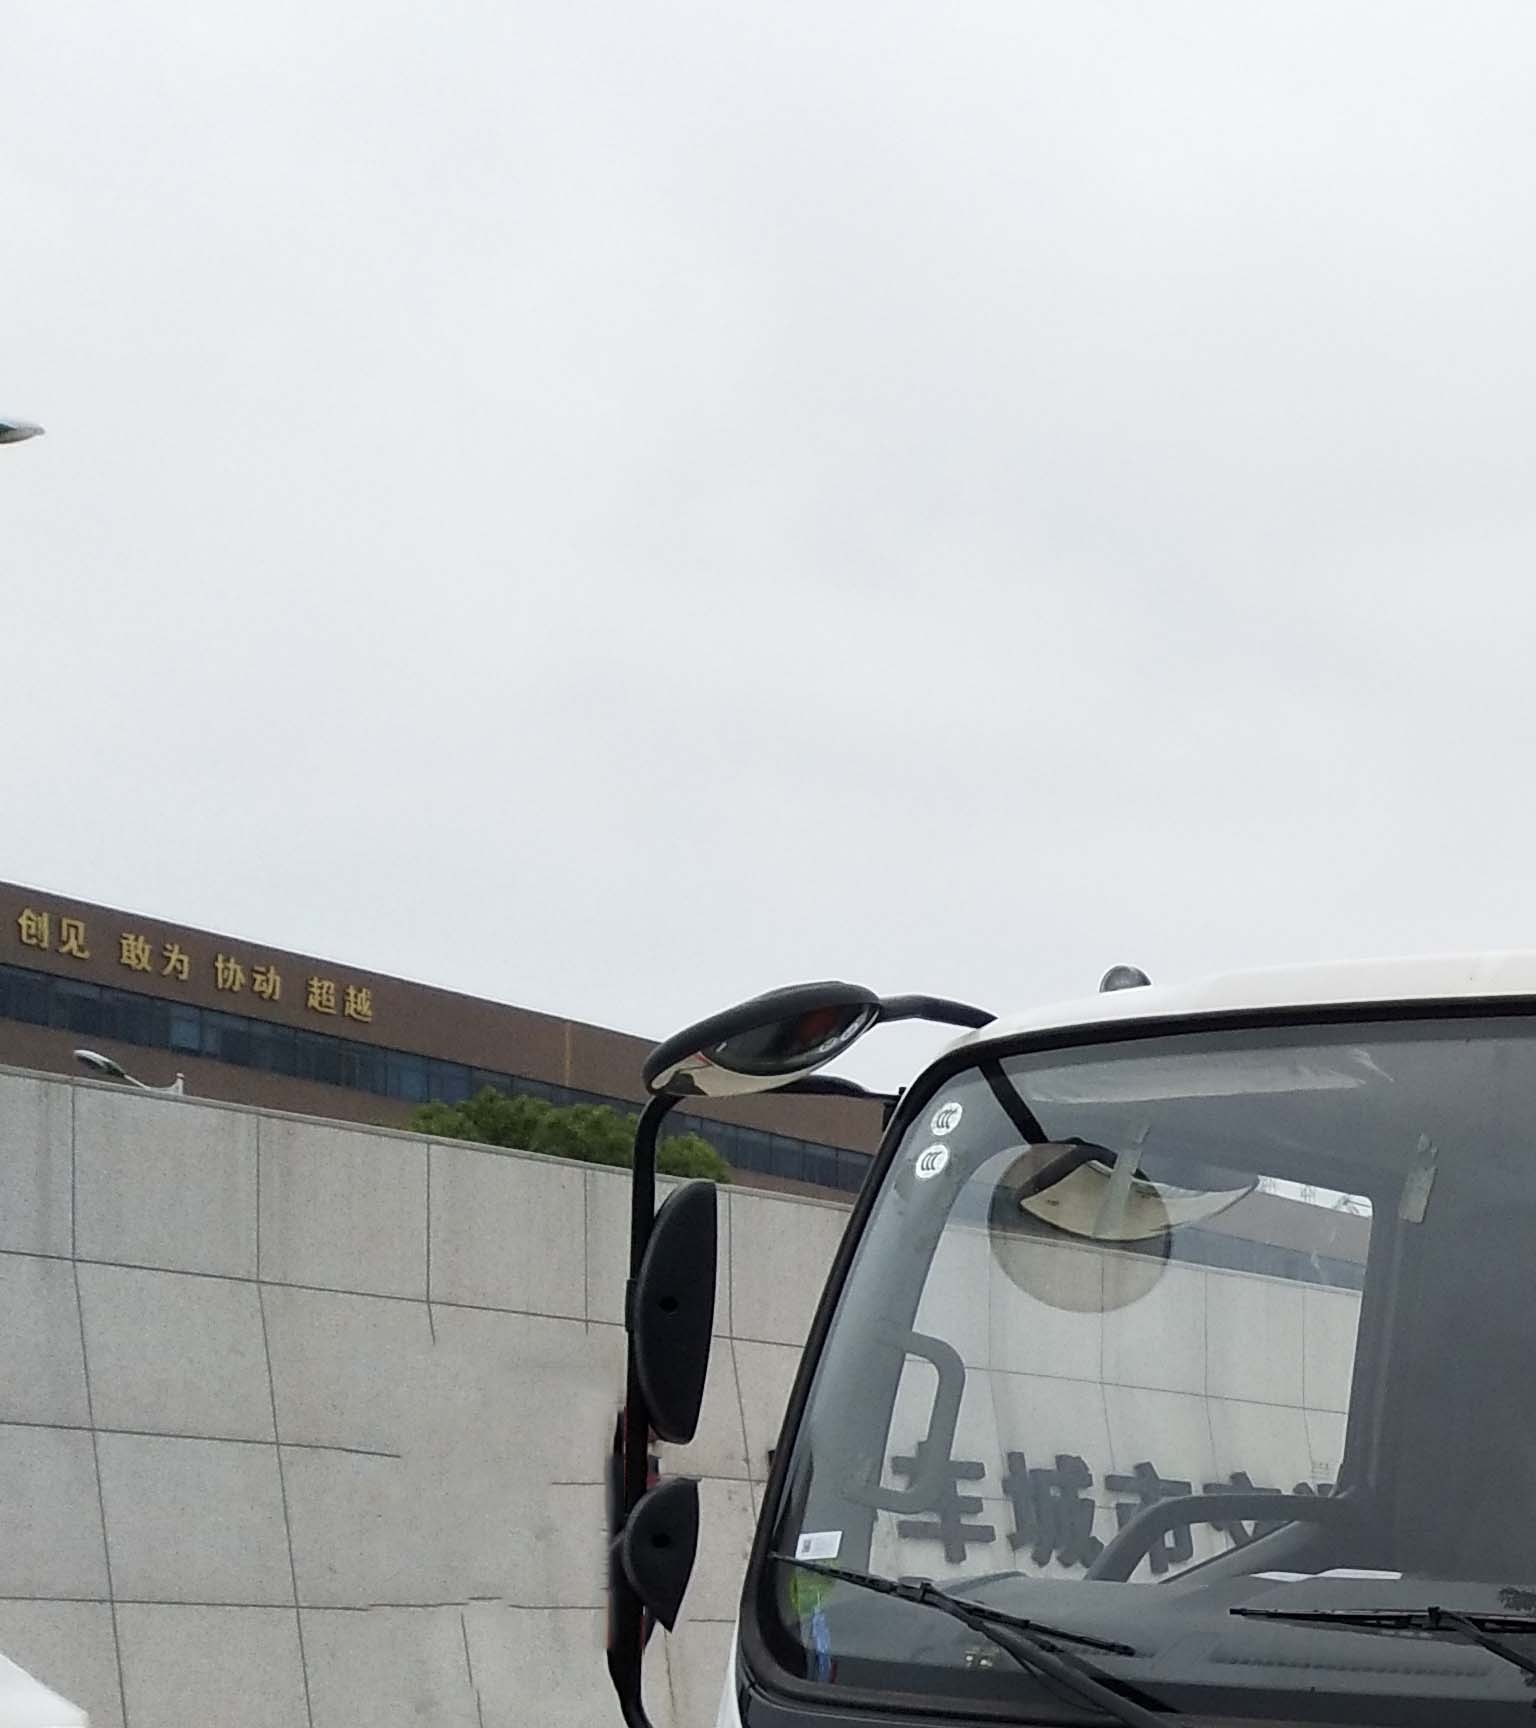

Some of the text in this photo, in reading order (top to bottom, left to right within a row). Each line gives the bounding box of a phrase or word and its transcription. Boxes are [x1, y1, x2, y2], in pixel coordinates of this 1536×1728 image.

[17, 908, 374, 1023] 创见 敢为 协动 超越
